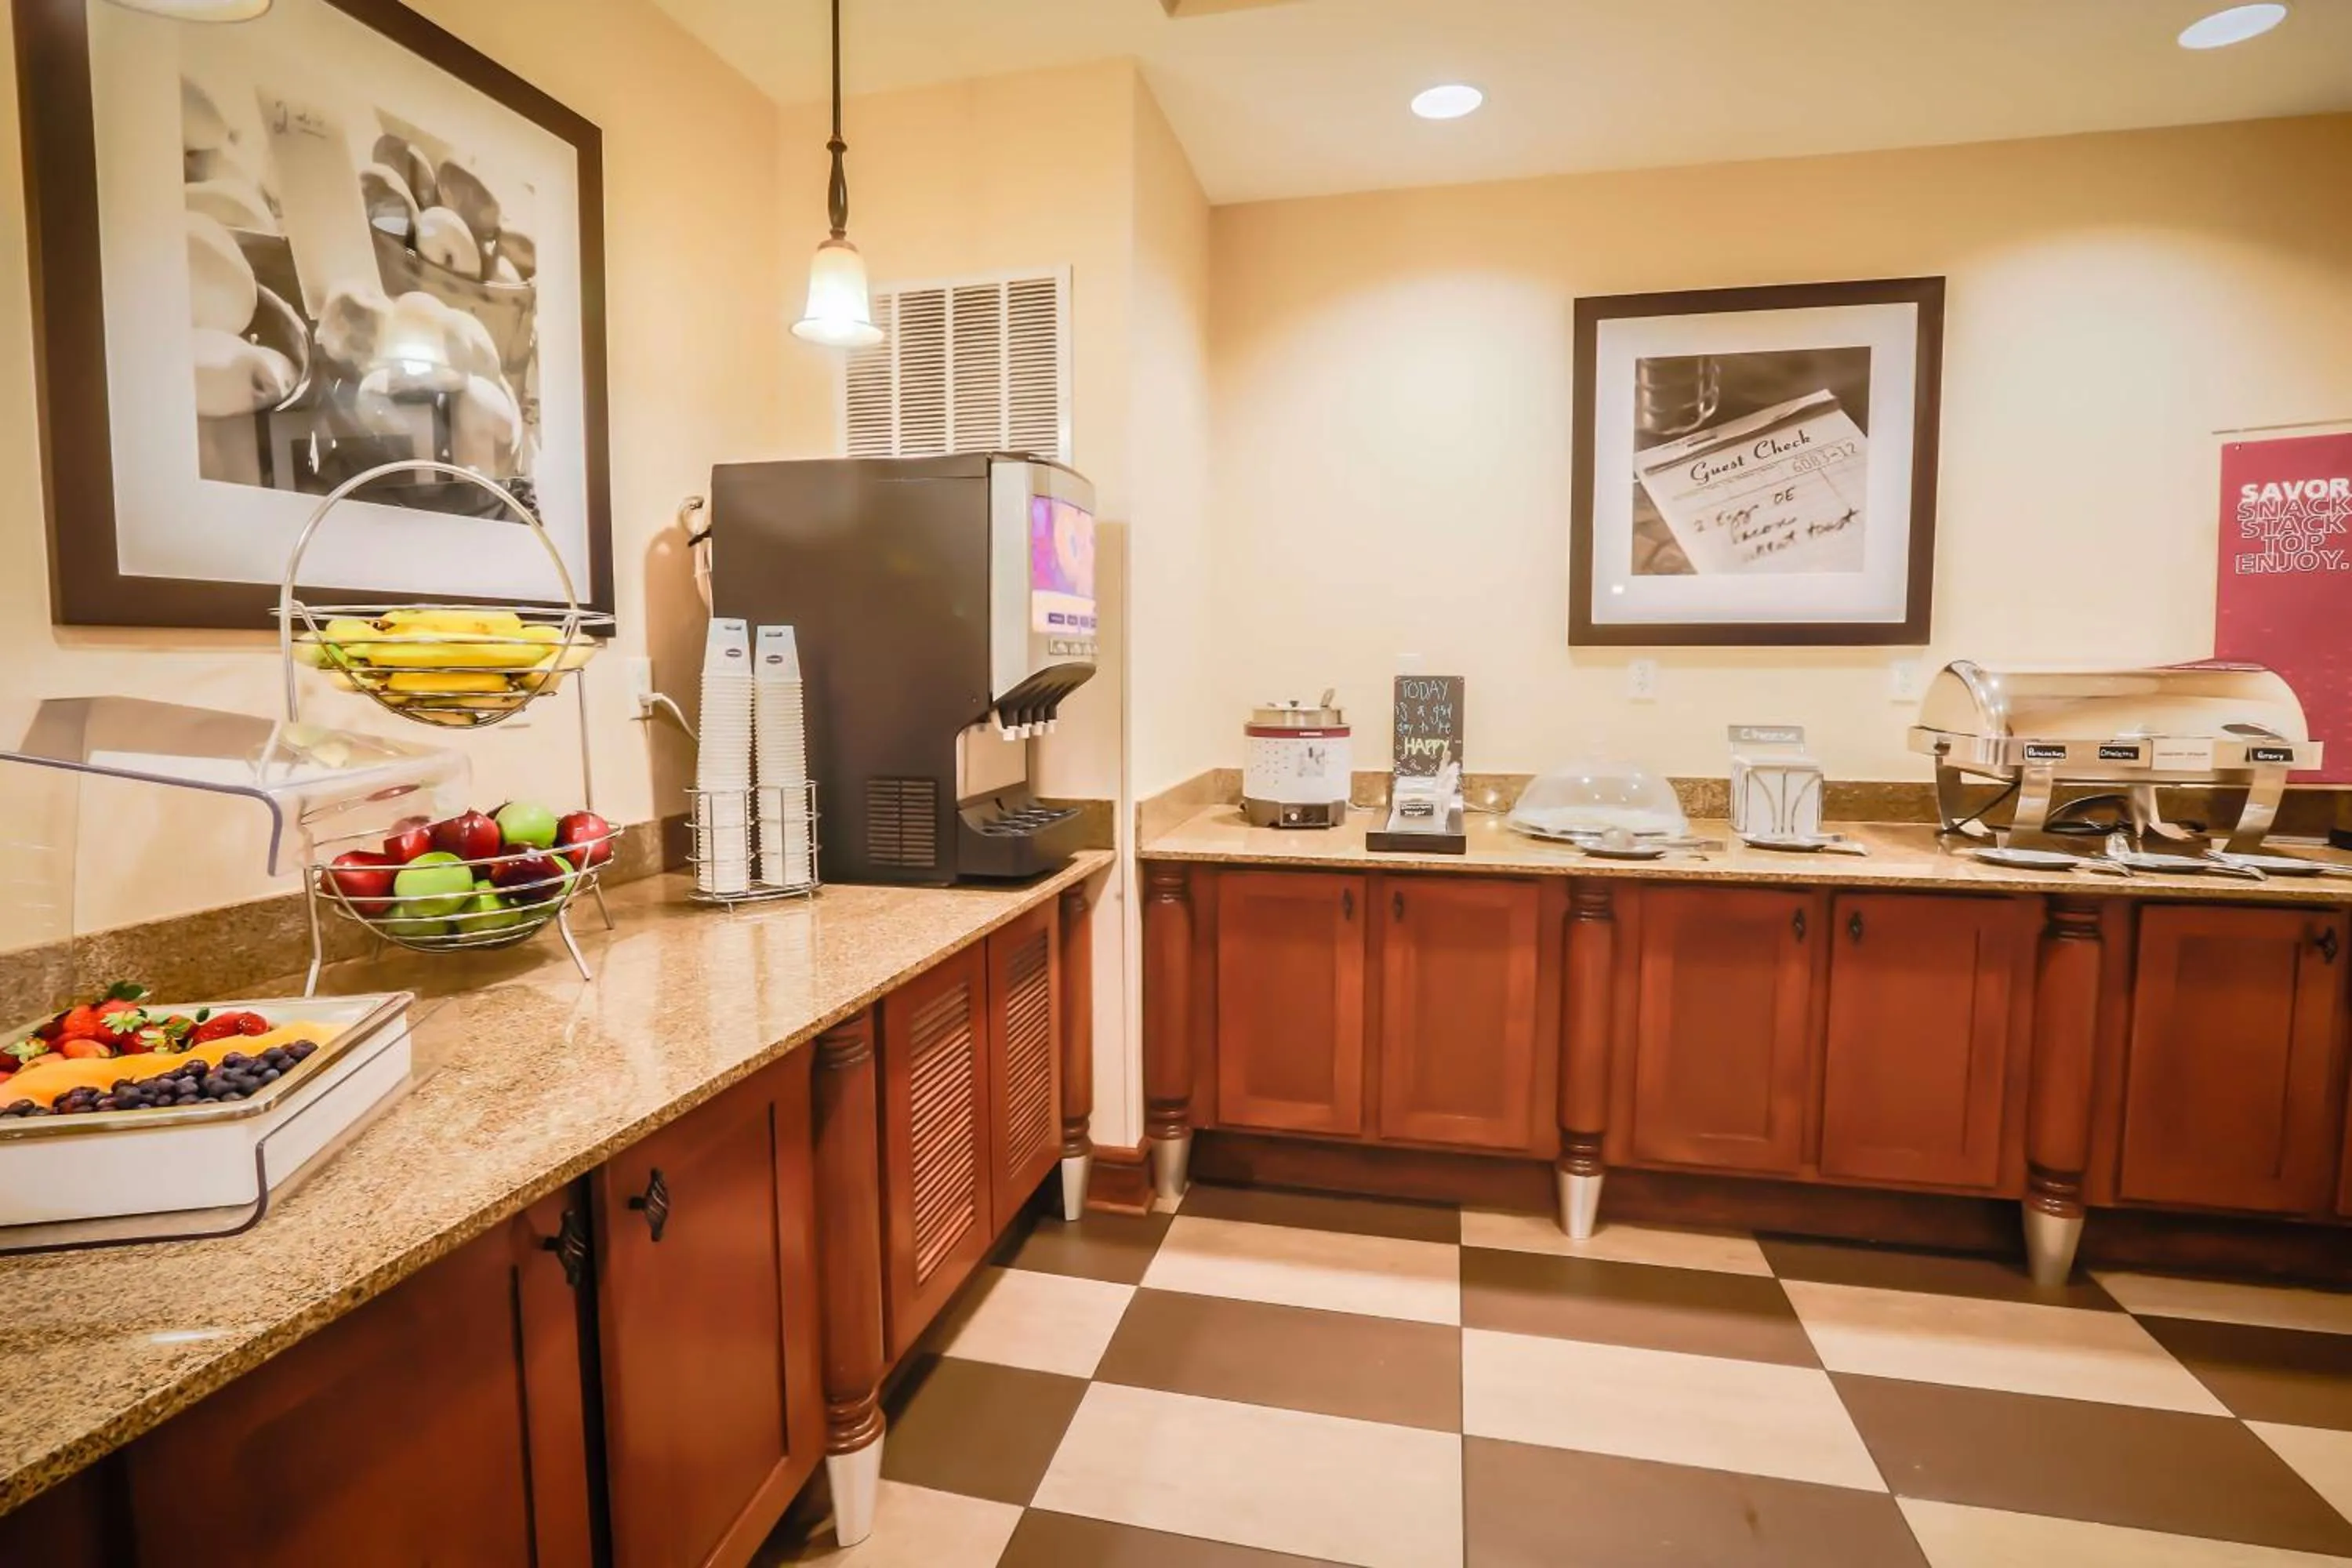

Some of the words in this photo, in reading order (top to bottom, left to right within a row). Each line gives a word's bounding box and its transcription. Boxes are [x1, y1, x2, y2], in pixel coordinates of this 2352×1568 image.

[1690, 455, 1745, 484] Guest
[1753, 429, 1811, 460] Check
[2241, 477, 2352, 502] SAVOR
[2238, 496, 2352, 522] SNACK
[2241, 514, 2347, 539] STACK
[2261, 534, 2326, 555] TOP
[2235, 550, 2350, 575] ENJOY.
[1403, 680, 1449, 702] TODAY
[1404, 737, 1450, 755] HAPPY
